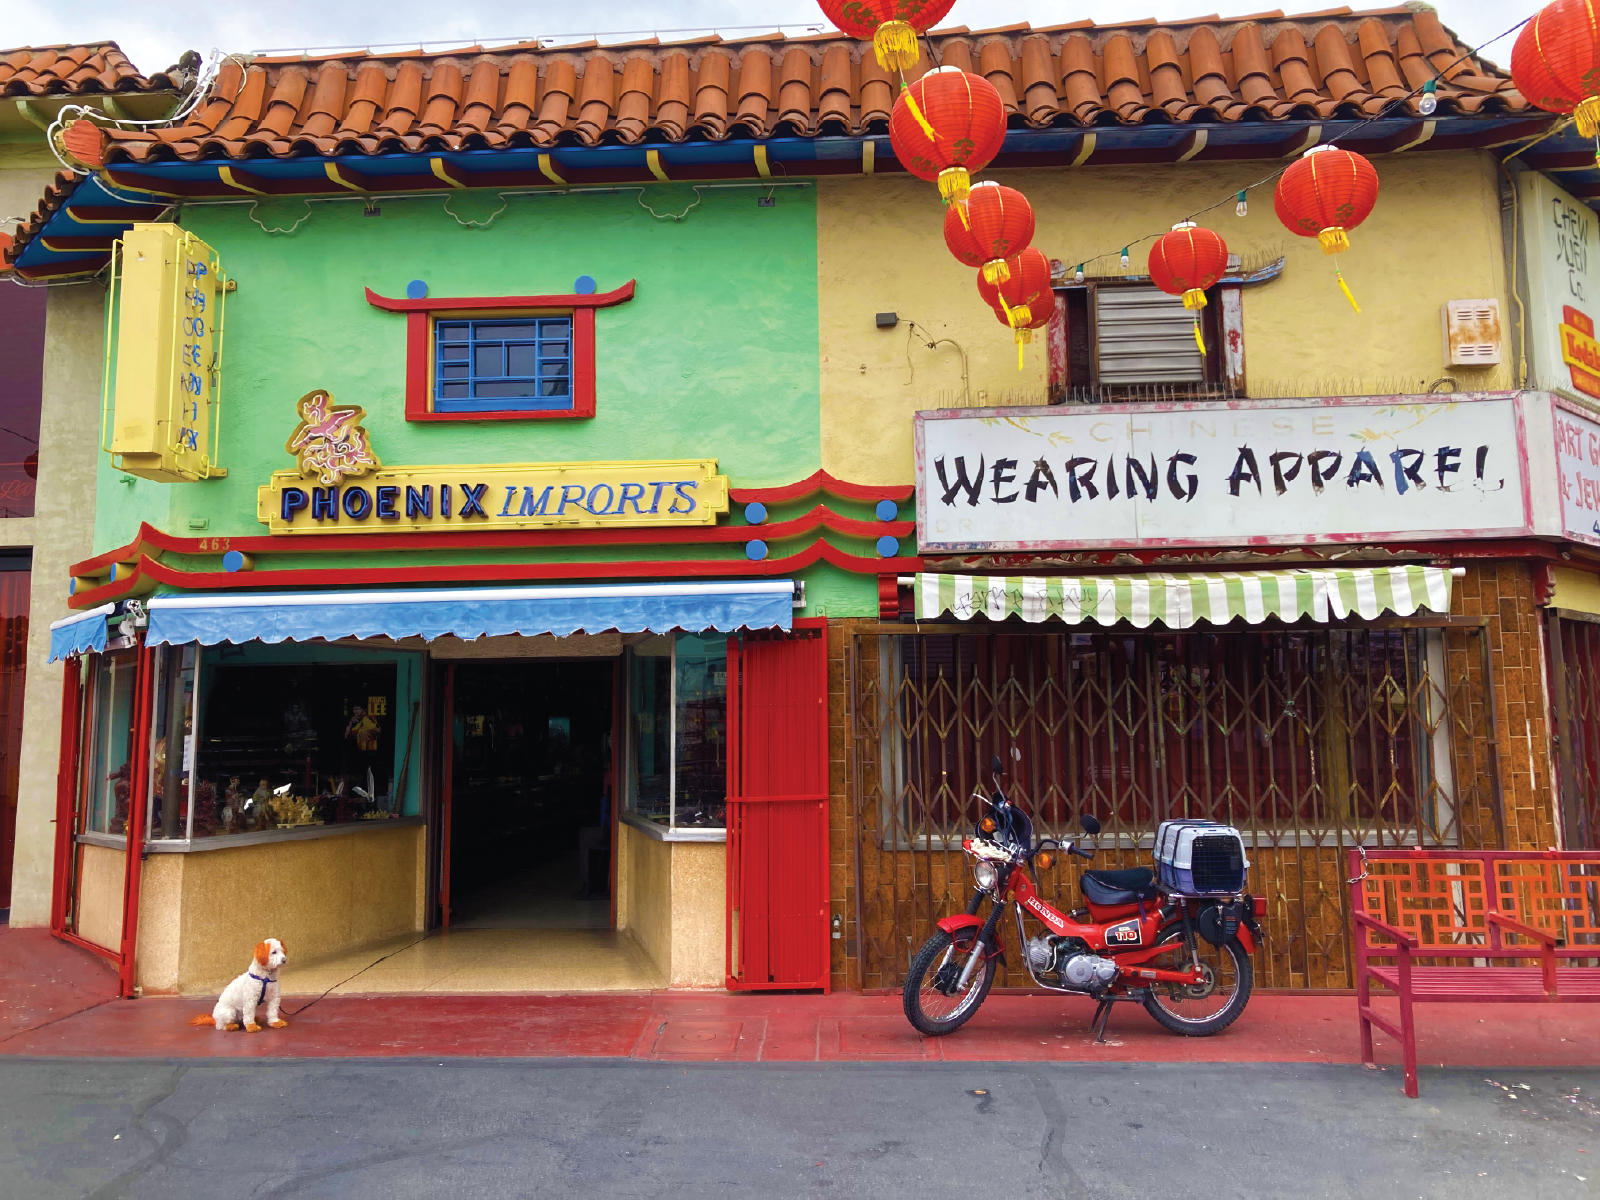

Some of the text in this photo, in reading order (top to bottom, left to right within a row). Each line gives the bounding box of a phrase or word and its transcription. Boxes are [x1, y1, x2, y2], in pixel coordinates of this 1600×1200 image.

[1557, 416, 1584, 461] ART
[934, 442, 1505, 507] WEARING APPAREL
[281, 480, 699, 522] PHOENIX IMPORTS
[199, 537, 231, 551] 463
[368, 702, 387, 716] LEE
[1027, 895, 1065, 929] HONDA
[1114, 930, 1138, 941] 110
